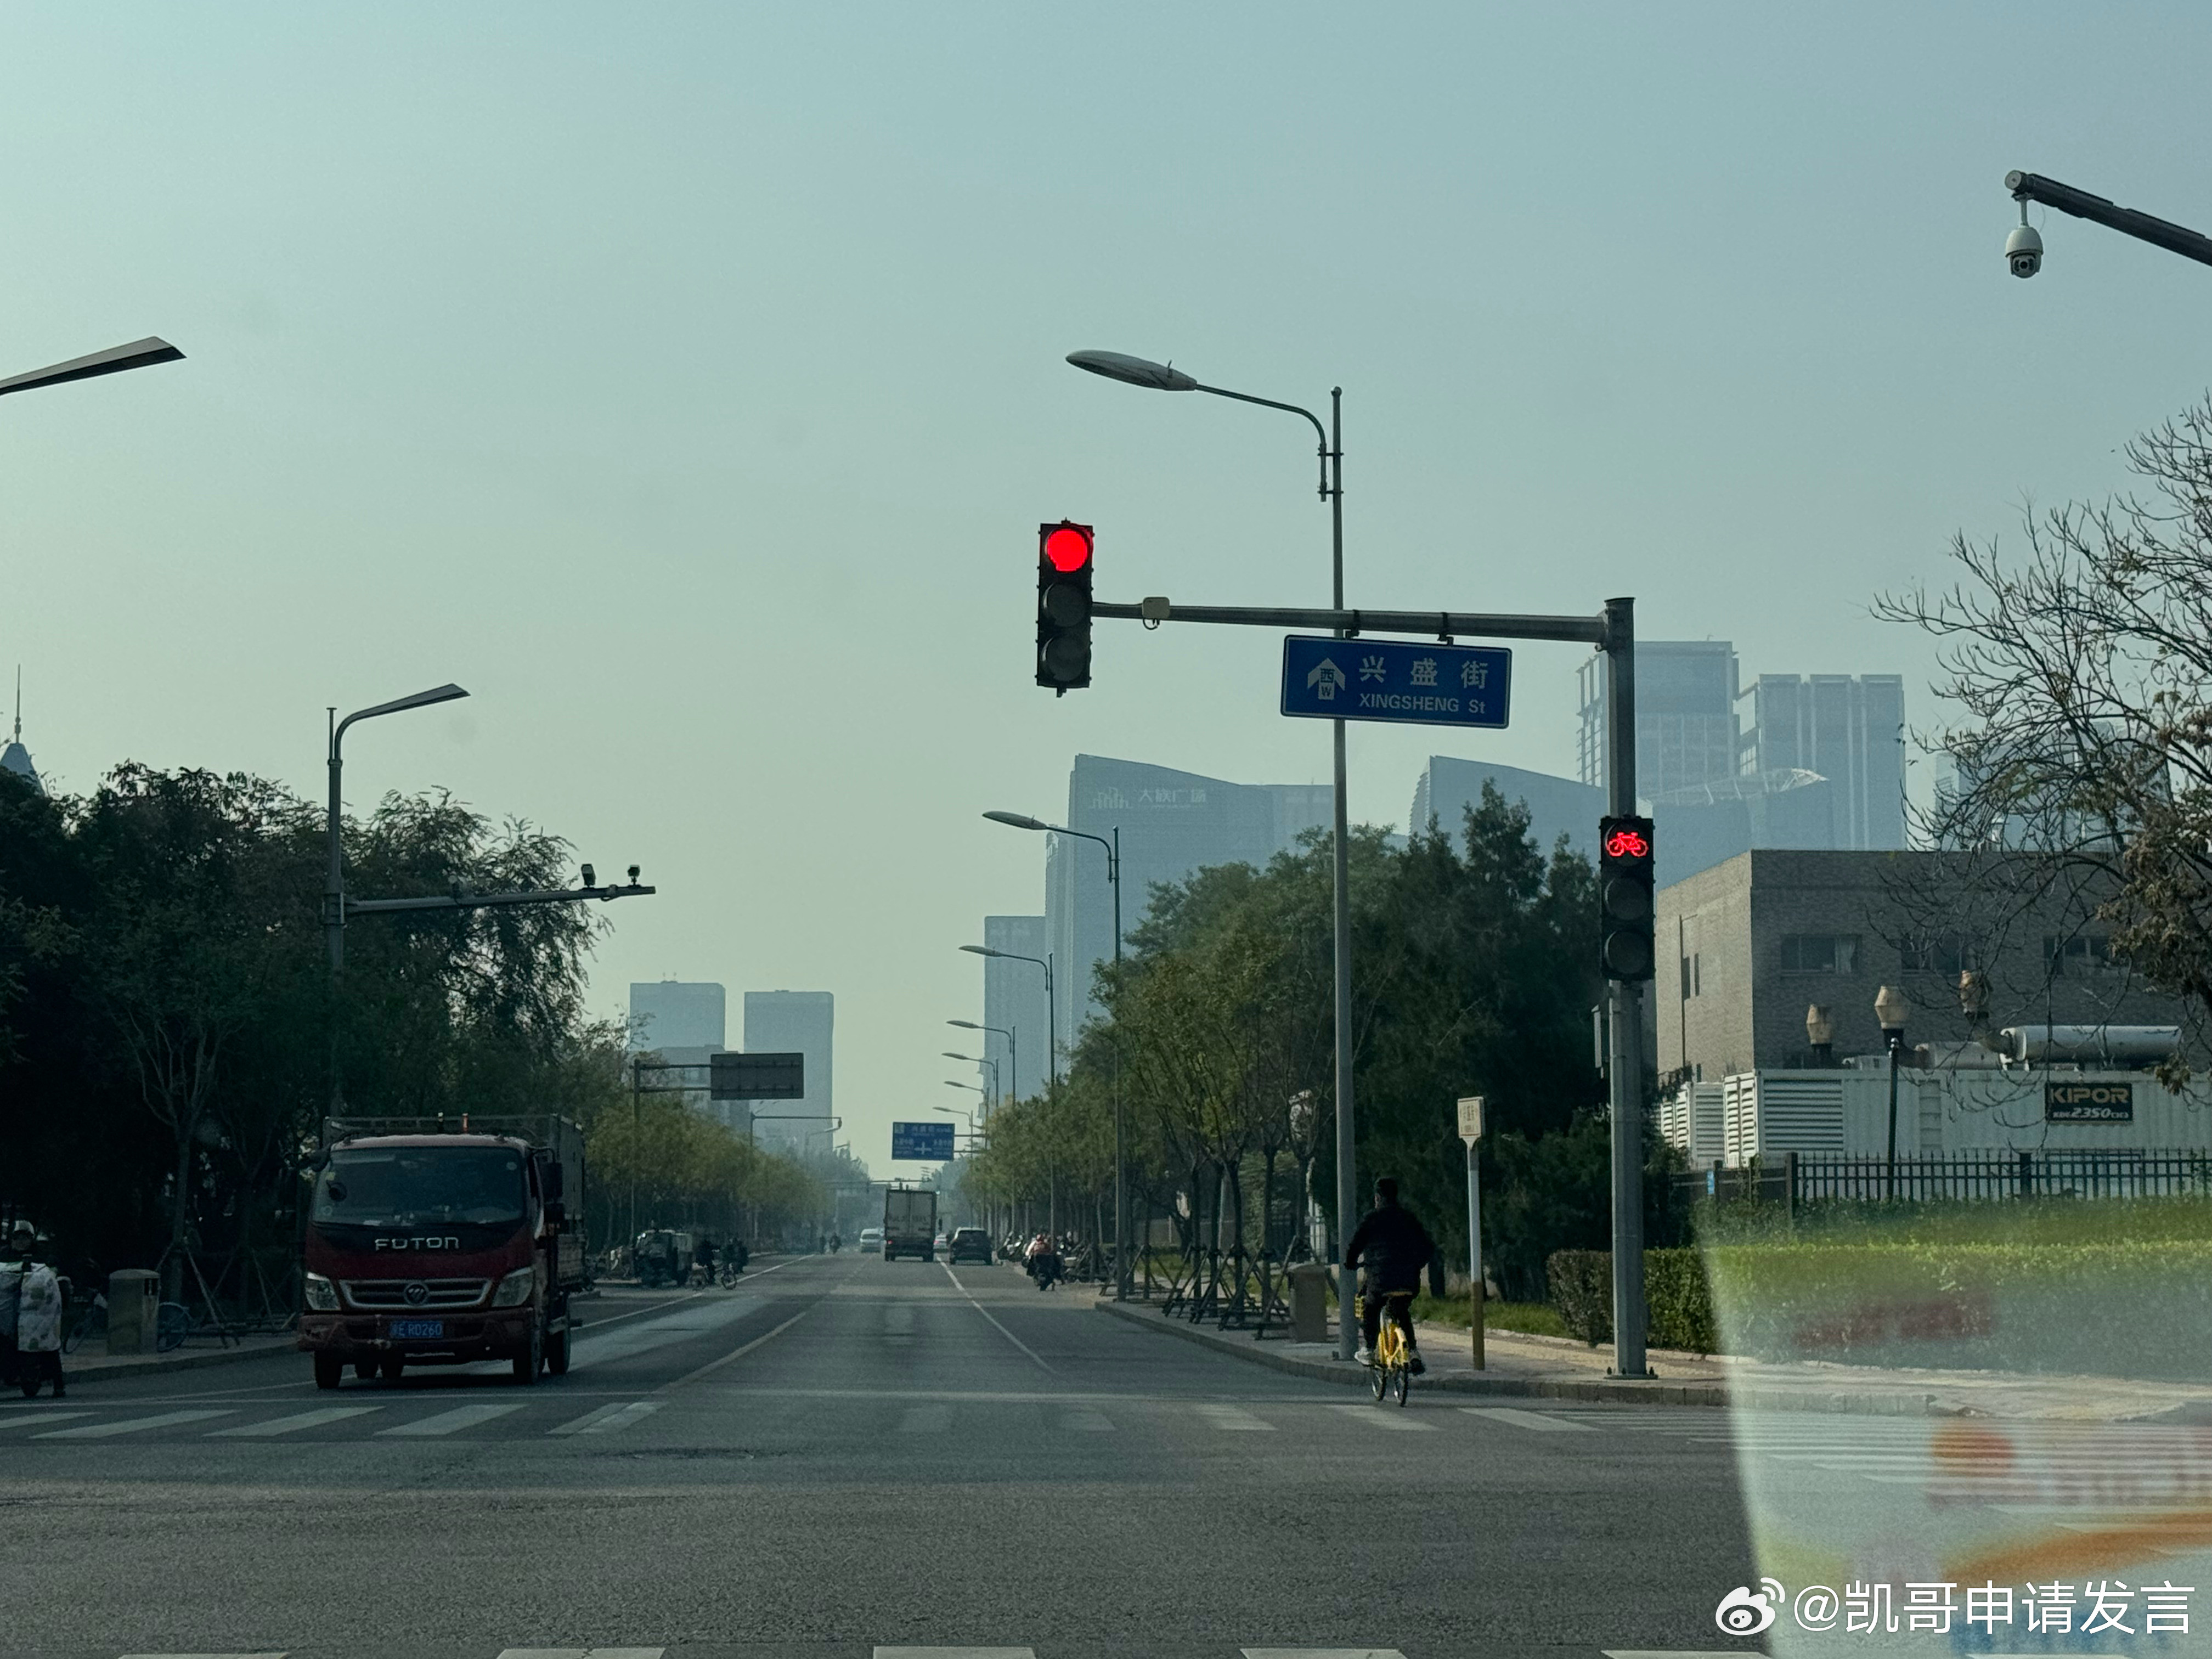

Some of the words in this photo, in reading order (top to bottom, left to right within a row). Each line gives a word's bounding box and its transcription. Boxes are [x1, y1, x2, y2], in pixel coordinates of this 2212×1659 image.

[1320, 668, 1335, 684] 西
[1359, 656, 1488, 689] 兴盛街
[1321, 685, 1332, 697] W
[1359, 693, 1459, 713] XINGSHENG
[1468, 698, 1486, 714] St
[2050, 1087, 2128, 1103] KIPOR
[374, 1237, 459, 1250] FOTON
